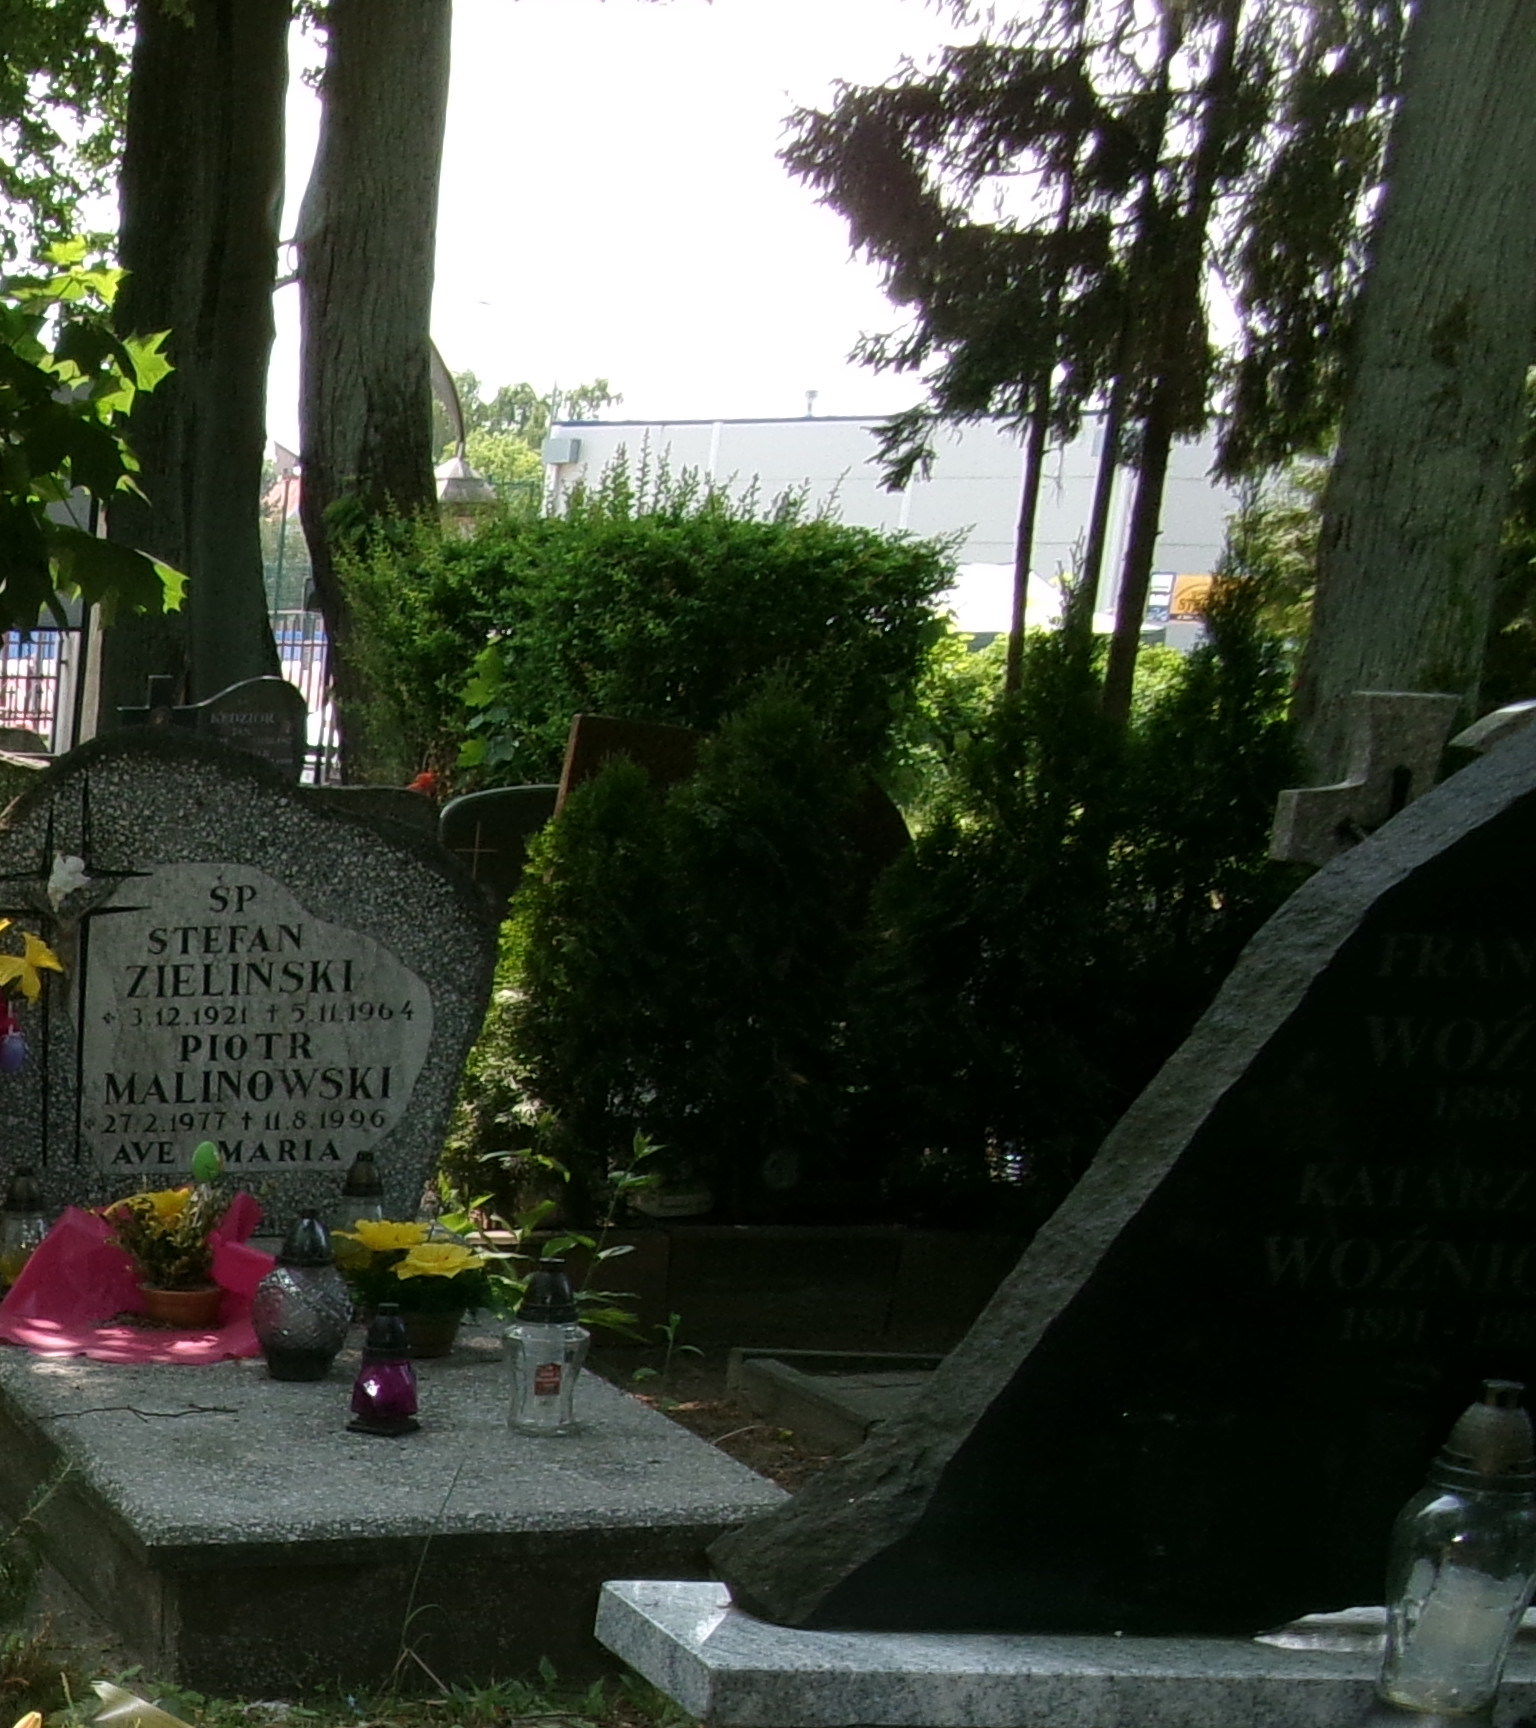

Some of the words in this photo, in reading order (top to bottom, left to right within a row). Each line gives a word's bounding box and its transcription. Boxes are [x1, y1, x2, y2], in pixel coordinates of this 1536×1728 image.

[147, 923, 304, 957] STEFAN
[125, 952, 356, 1000] ZIELIŃSKI
[179, 1032, 314, 1063] PIOTR
[103, 1065, 394, 1107] MALINOWSKI
[110, 1141, 176, 1167] AVE
[217, 1139, 342, 1165] MARIA
